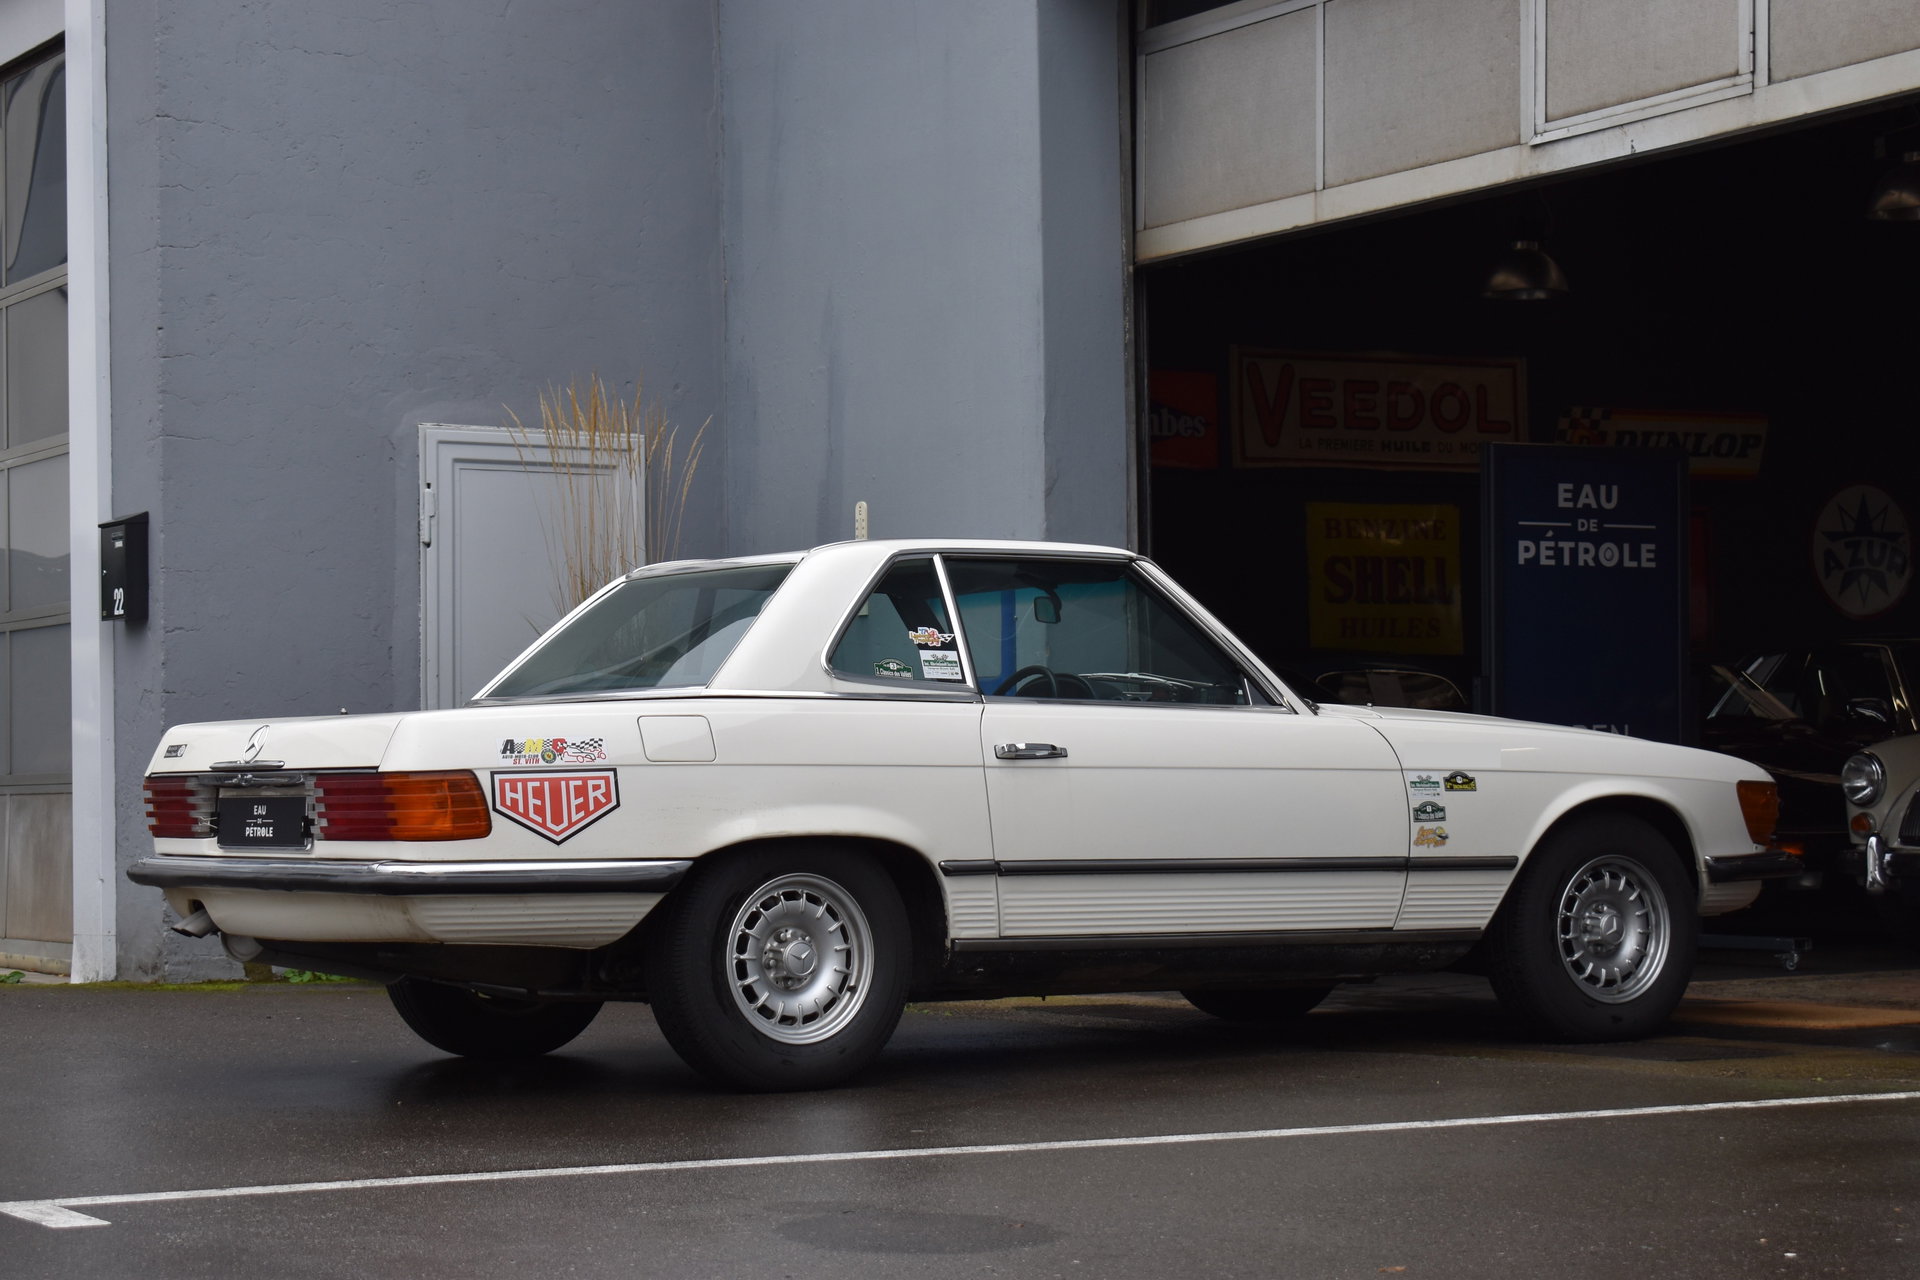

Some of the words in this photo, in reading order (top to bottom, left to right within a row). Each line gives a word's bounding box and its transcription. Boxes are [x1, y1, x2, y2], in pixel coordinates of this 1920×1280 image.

[1246, 361, 1511, 447] VEEDOL
[1299, 438, 1312, 449] LA
[1380, 440, 1431, 453] HUILE
[1438, 441, 1453, 454] DU
[1614, 430, 1763, 458] DUNLOP
[1557, 482, 1618, 510] EAU
[1324, 517, 1446, 541] BENZINE
[1577, 518, 1598, 532] DE
[1518, 529, 1656, 568] PÉTROLE
[1823, 539, 1907, 579] AZUR
[1324, 555, 1453, 605] SHELL
[113, 587, 124, 615] 22
[1339, 616, 1441, 639] HUILES
[253, 805, 267, 815] EAU
[504, 779, 606, 832] HEUER
[245, 823, 273, 837] PÉTROLE
